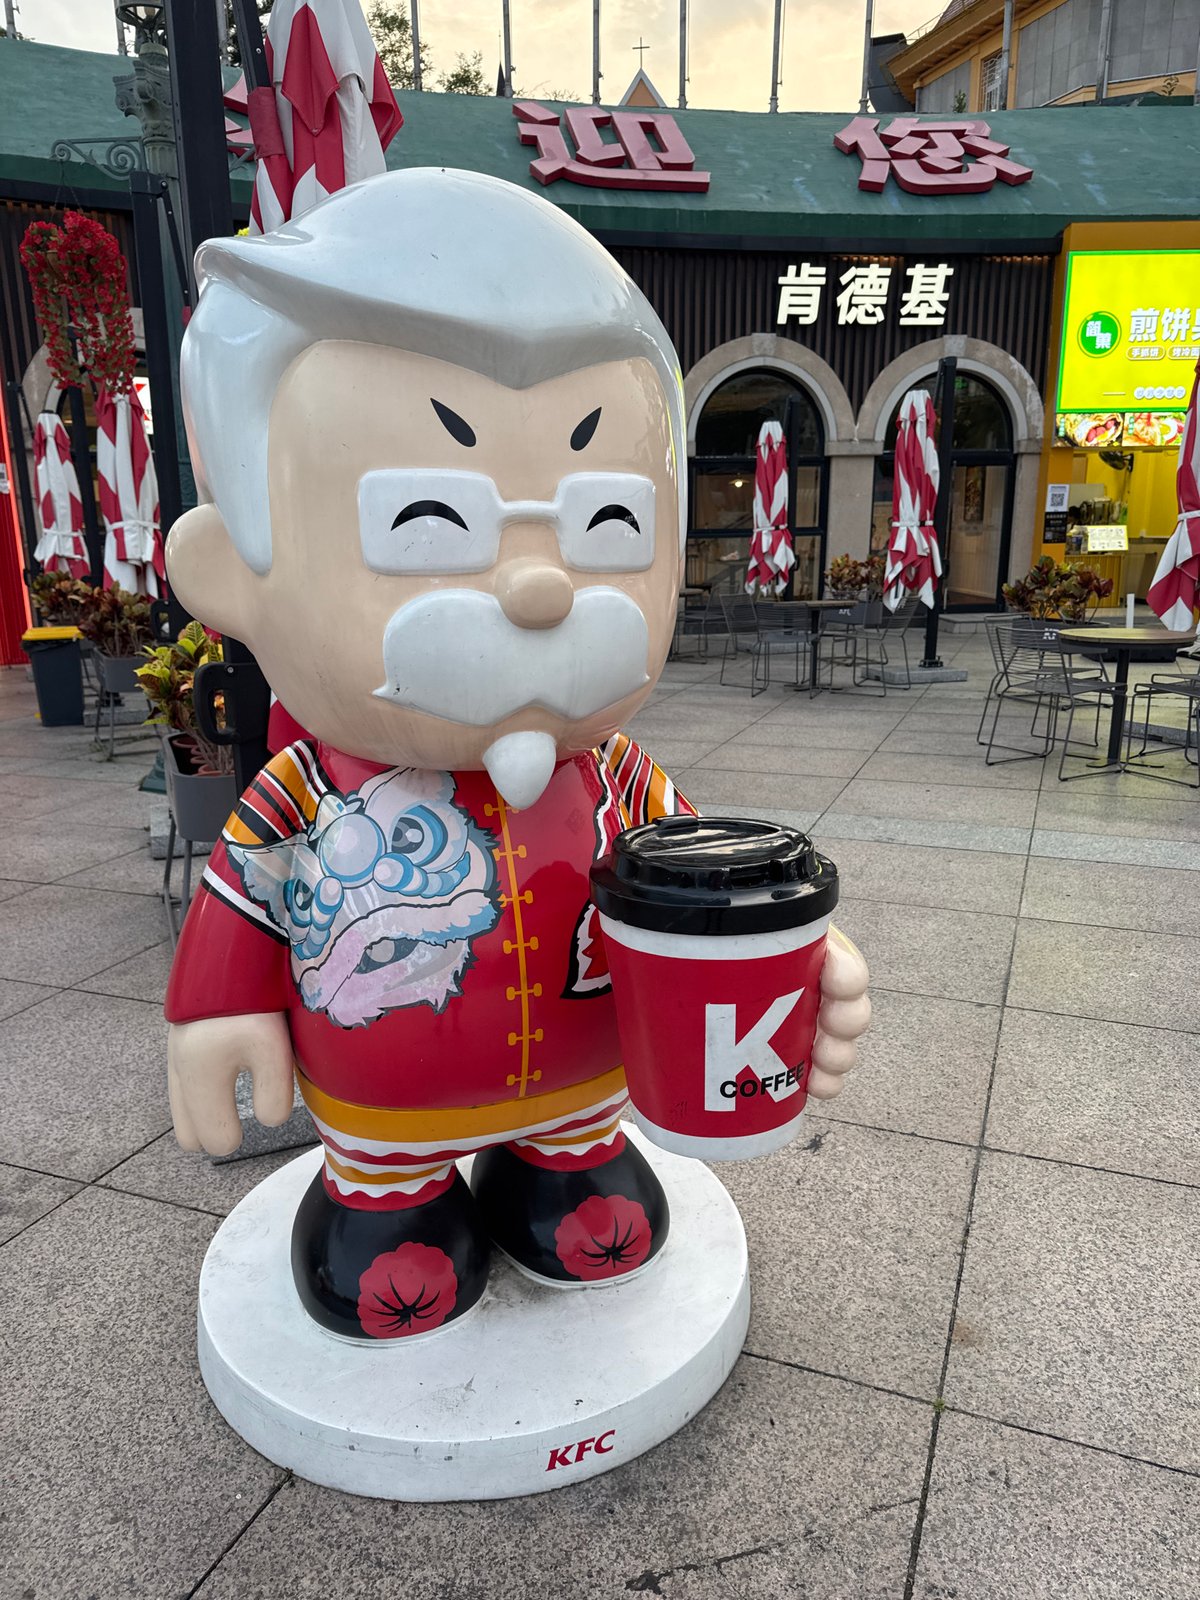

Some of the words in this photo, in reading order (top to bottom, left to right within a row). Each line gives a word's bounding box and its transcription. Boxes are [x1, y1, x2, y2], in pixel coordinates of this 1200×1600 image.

[776, 262, 955, 326] 肯德基
[704, 986, 806, 1112] K
[719, 1059, 806, 1099] COFFEE
[545, 1429, 616, 1472] KFC
